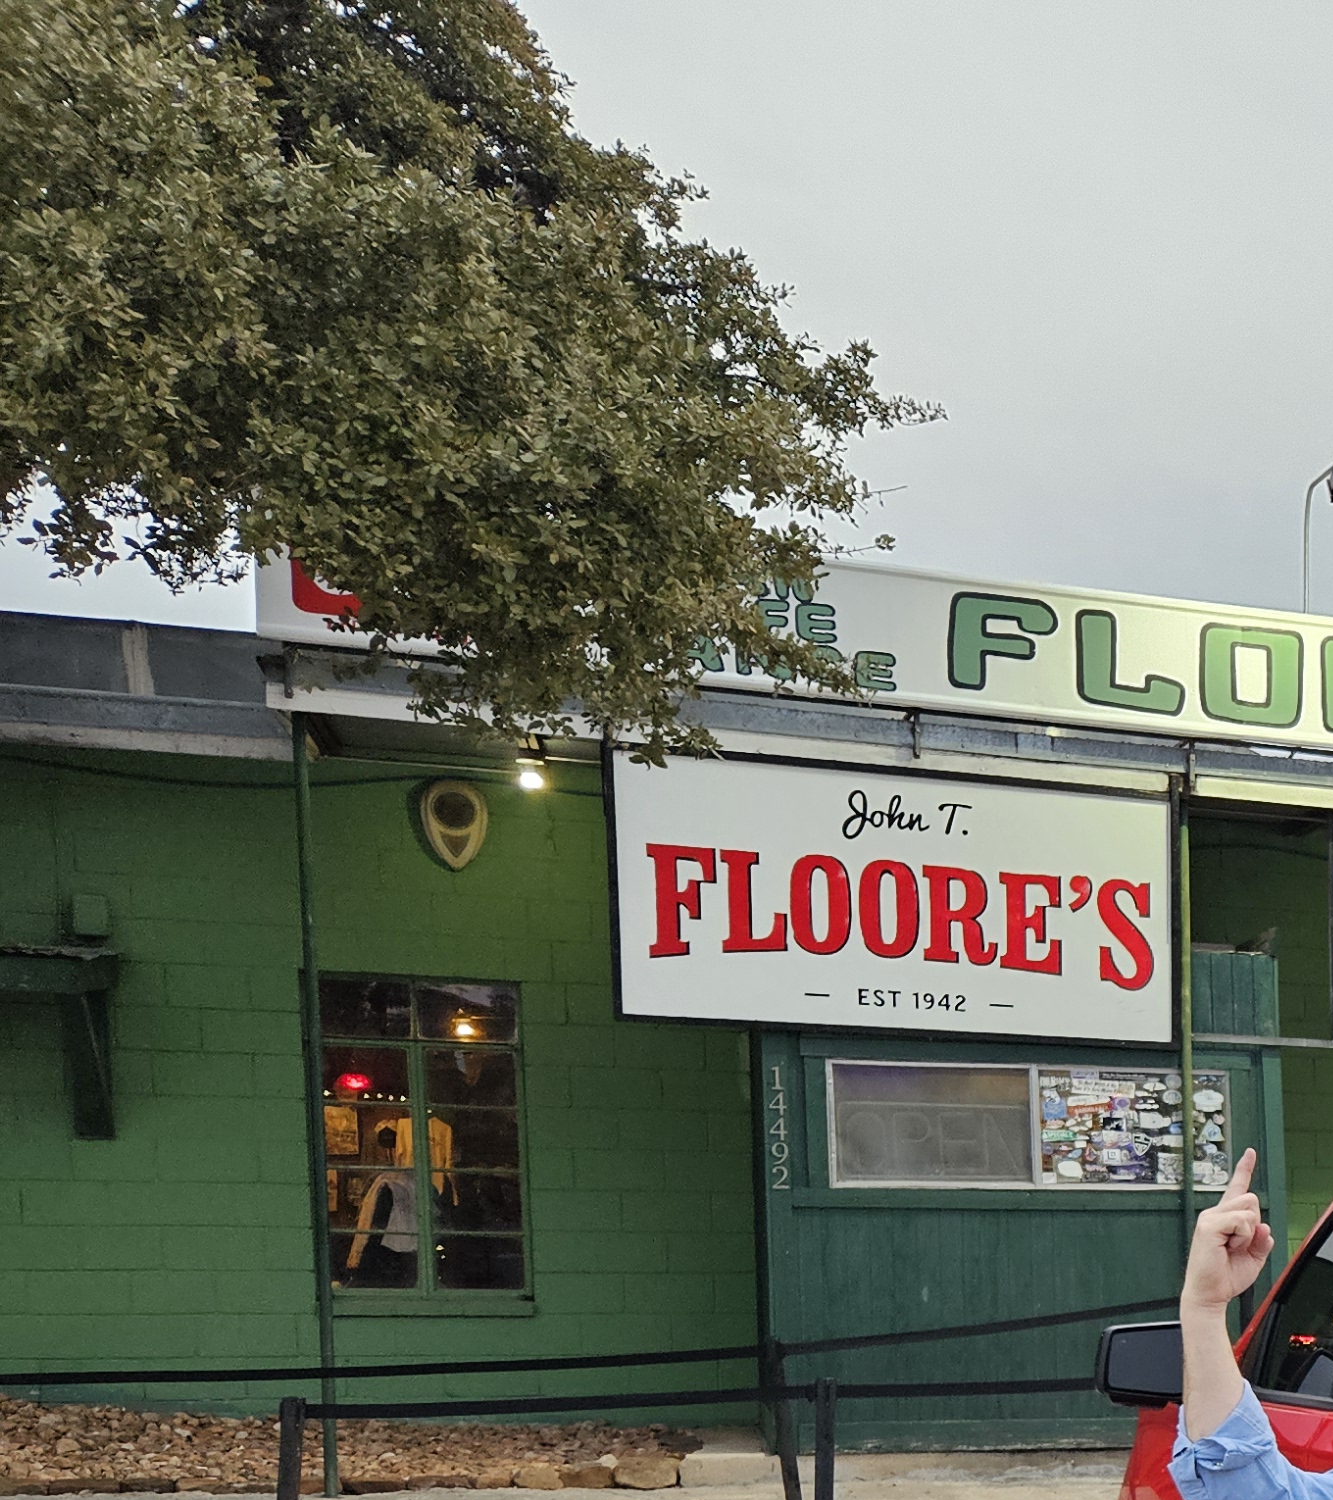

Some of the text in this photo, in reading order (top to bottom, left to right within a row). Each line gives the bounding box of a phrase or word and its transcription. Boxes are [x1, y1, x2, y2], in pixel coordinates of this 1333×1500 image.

[841, 788, 971, 840] John T.
[644, 841, 1155, 991] FLOORE'S
[857, 988, 967, 1013] EST 1942
[768, 1065, 791, 1190] 14492
